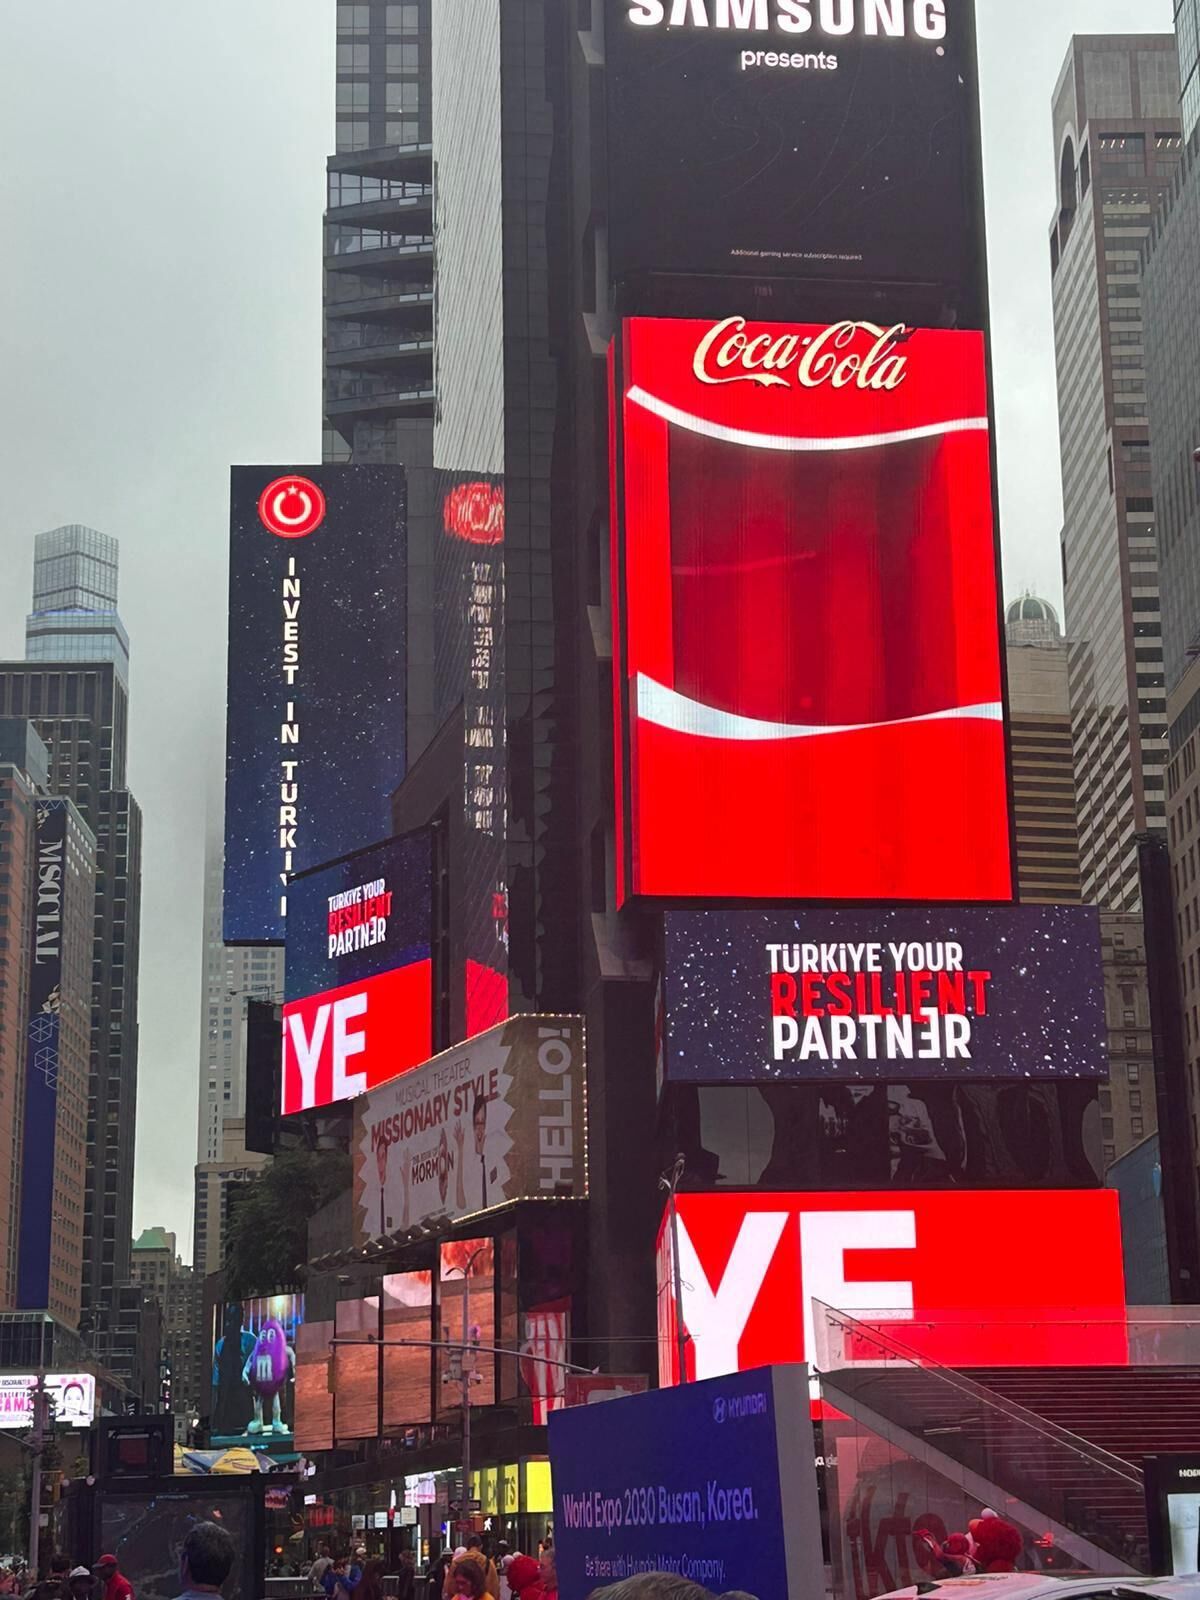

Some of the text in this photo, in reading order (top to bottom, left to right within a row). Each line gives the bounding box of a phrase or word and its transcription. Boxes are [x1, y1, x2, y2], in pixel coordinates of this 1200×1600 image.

[628, 0, 946, 39] SAMSUNG
[741, 51, 838, 70] presents
[693, 316, 906, 390] Coca-Cola
[282, 557, 301, 685] INVEST
[281, 702, 299, 744] IN
[363, 878, 385, 900] YOUR
[328, 891, 393, 936] RESILIENT
[888, 941, 963, 972] YOUR
[770, 970, 992, 1023] RESILIENT
[432, 1058, 471, 1091] THEATER
[371, 1067, 500, 1152] MISSIONARY STYLE
[537, 1027, 574, 1190] HELLO!
[412, 1150, 454, 1186] MORMON
[728, 1392, 767, 1418] HYUNDAI
[563, 1480, 759, 1536] World Expo 2030 Busan, Korea.
[682, 1553, 726, 1584] Company.
